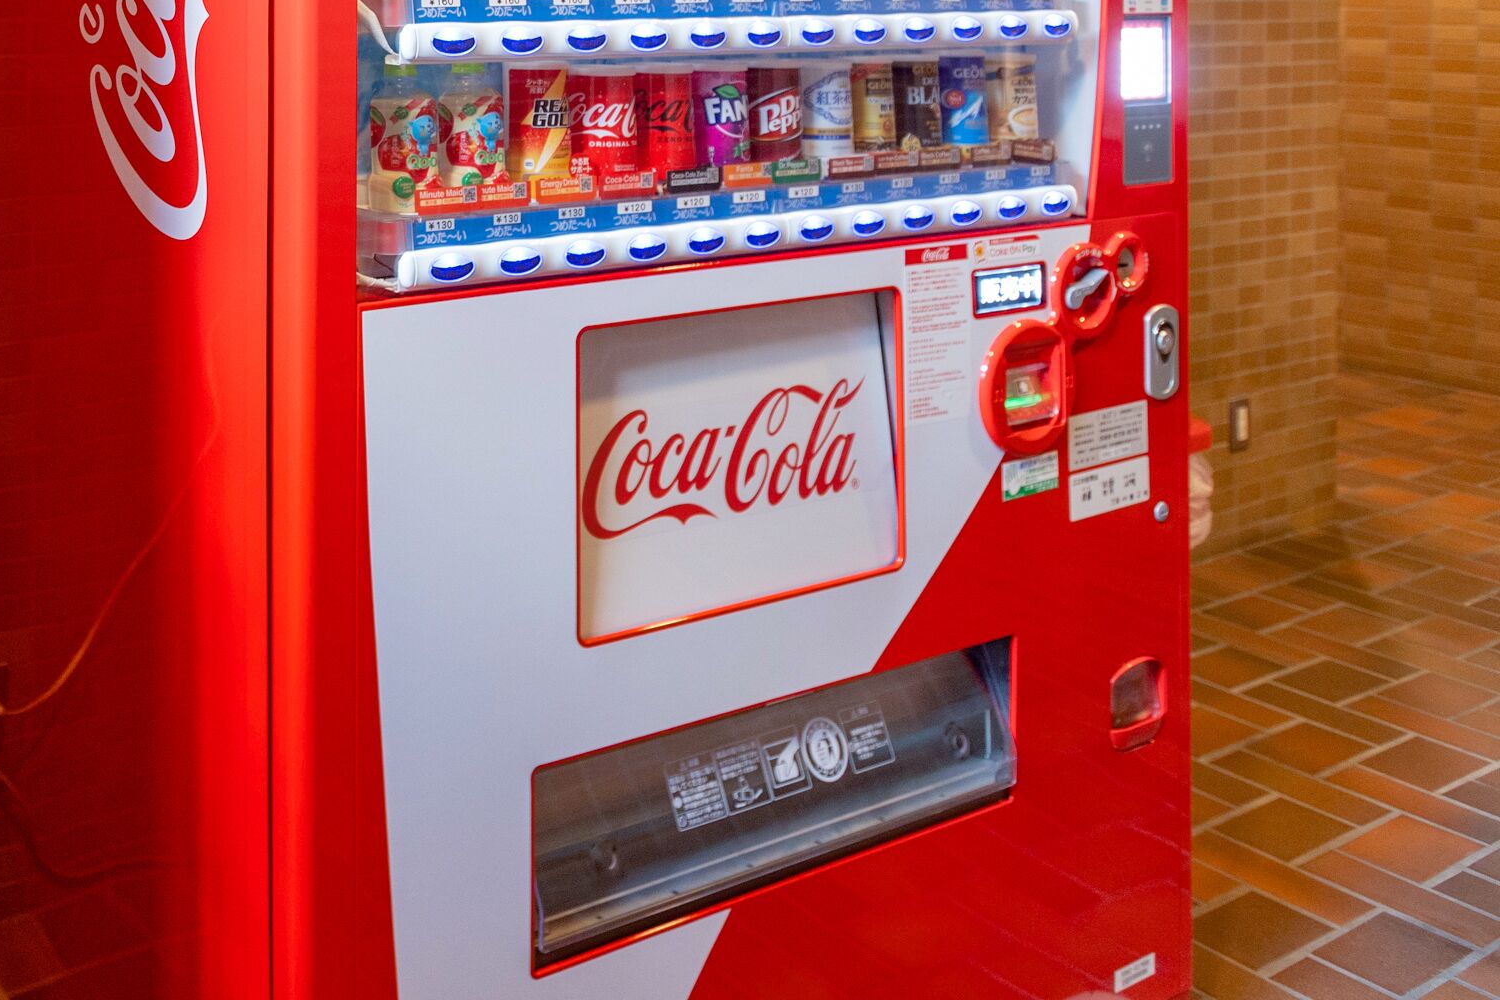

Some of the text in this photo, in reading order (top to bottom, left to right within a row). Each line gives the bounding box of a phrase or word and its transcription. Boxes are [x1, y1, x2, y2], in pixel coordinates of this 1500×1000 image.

[908, 87, 940, 105] BLA
[704, 95, 748, 124] FAN
[532, 112, 569, 128] GOL
[759, 103, 800, 135] Pepp
[540, 177, 580, 189] Energy Drink
[605, 174, 639, 184] Coca-Cola
[419, 187, 463, 199] Minute Maid
[497, 184, 513, 193] Maid
[739, 192, 759, 201] ¥120
[684, 198, 704, 206] ¥120
[561, 208, 583, 217] ¥130
[624, 204, 646, 212] ¥120
[495, 214, 519, 223] ¥130
[428, 220, 453, 230] ¥130
[582, 375, 866, 539] Coca-Cola
